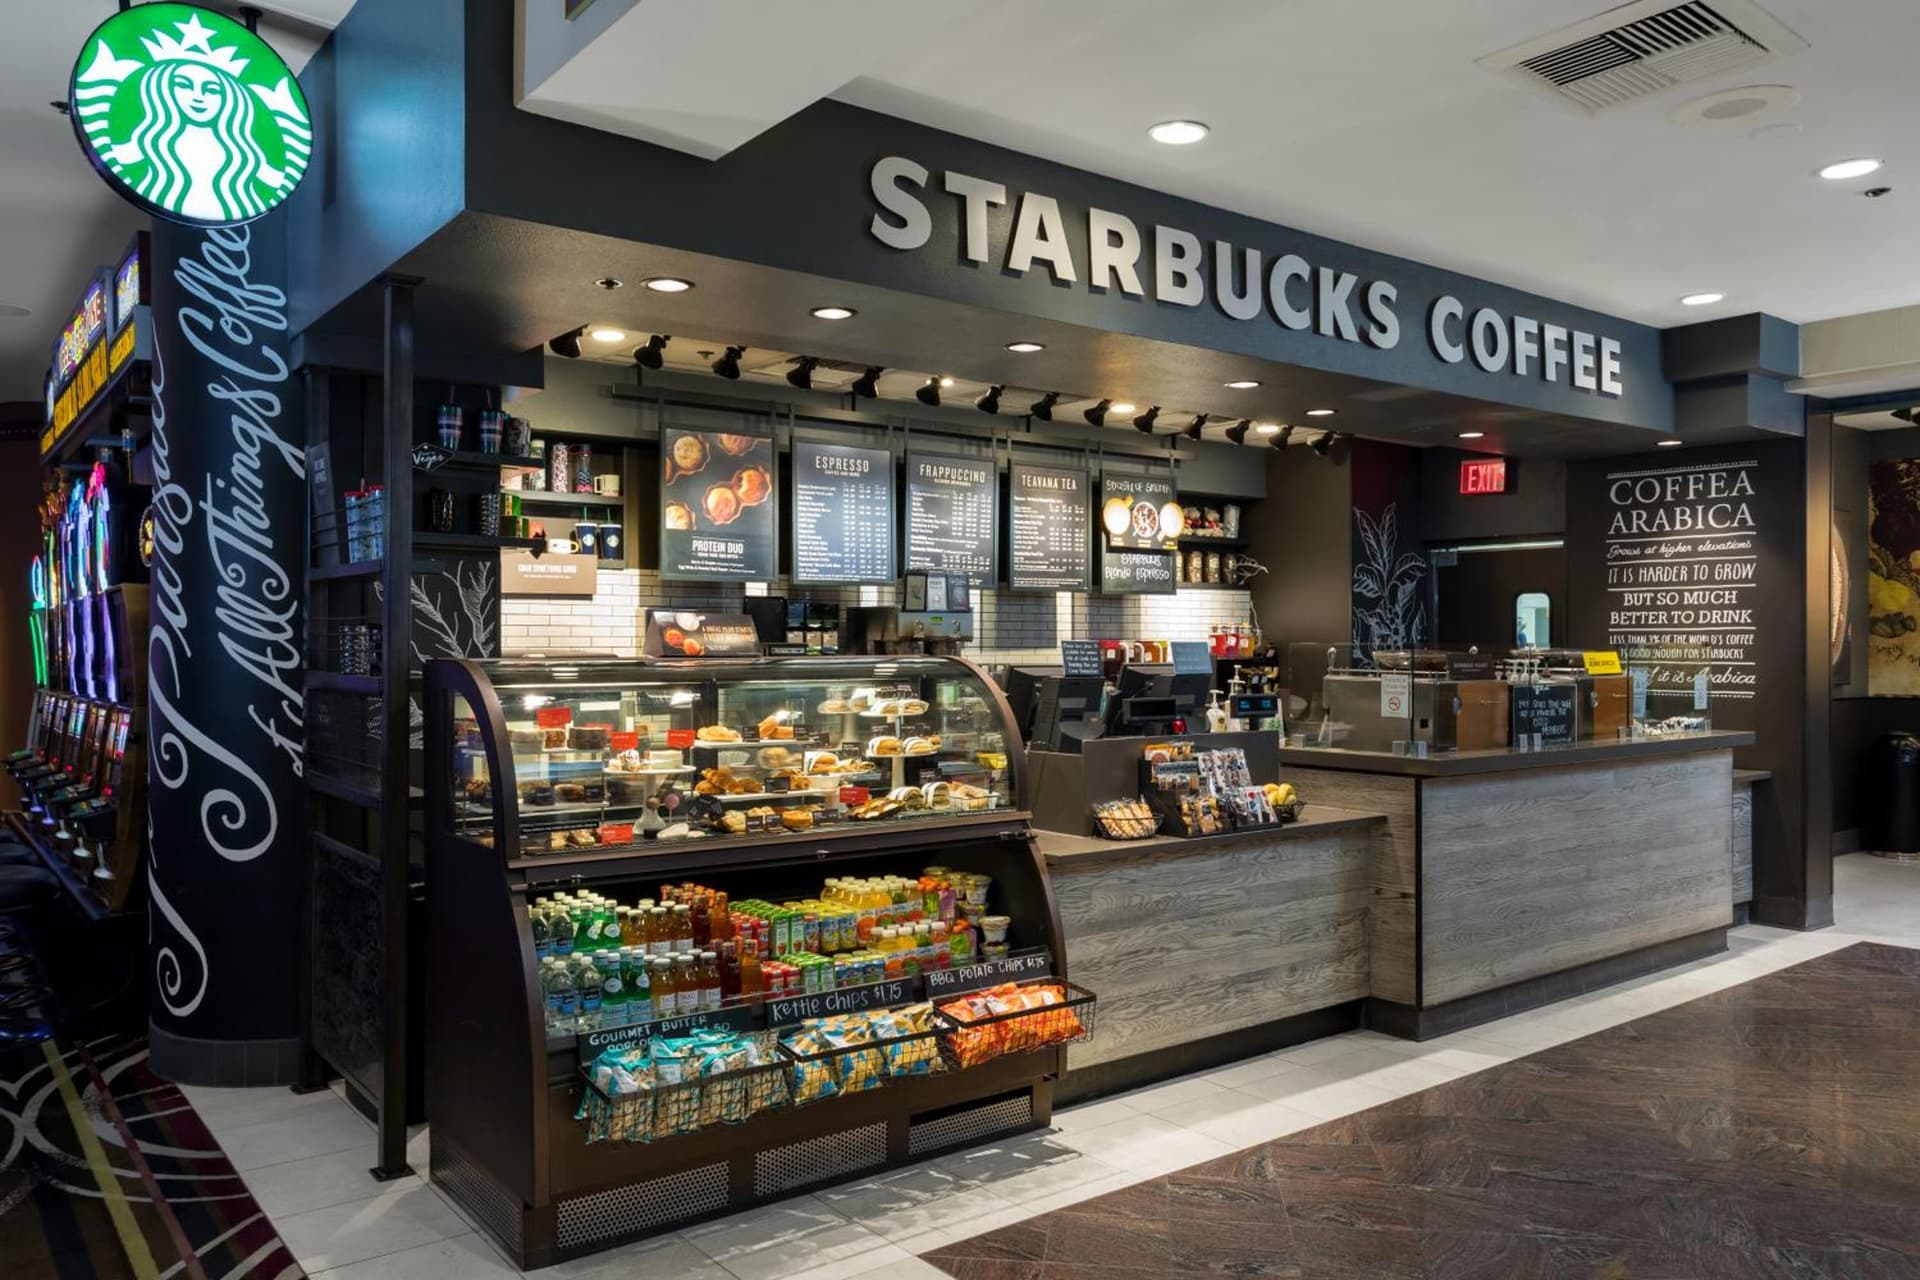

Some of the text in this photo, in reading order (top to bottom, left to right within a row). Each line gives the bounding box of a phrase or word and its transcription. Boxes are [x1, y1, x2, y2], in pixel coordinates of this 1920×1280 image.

[870, 156, 1624, 396] STARBUCKS COFFEE
[815, 455, 870, 473] ESPRESSO
[919, 463, 986, 484] FRAPPUCCINO
[199, 375, 306, 601] Things
[1021, 474, 1078, 490] TEAVANA TEA
[1467, 464, 1501, 493] EXIT
[1609, 470, 1756, 506] COFFEA
[1608, 503, 1756, 534] ARABICA
[692, 540, 744, 554] PROTEIN DUO
[1645, 545, 1657, 555] at
[1659, 542, 1693, 558] higher
[1698, 540, 1752, 553] elevations
[1608, 563, 1757, 584] IT IS HARDER TO GROW
[1623, 590, 1738, 606] BUT SO MUCH
[1610, 609, 1752, 625] BETTER TO DRINK
[1609, 635, 1625, 645] LESS
[1628, 634, 1647, 644] THAN
[1661, 634, 1671, 644] OF
[1673, 634, 1687, 644] THE
[1688, 633, 1723, 645] WORLD'S
[1726, 633, 1755, 645] COFFEE
[1652, 647, 1682, 659] ENOUGH
[1684, 647, 1699, 658] FOR
[1701, 647, 1744, 660] STARBUCKS
[1657, 669, 1671, 682] it
[1672, 670, 1686, 684] is
[929, 972, 956, 986] BBQ
[959, 964, 993, 983] POTATO
[873, 982, 902, 1002] $1.75
[589, 1014, 707, 1046] GOURMET BUTTER
